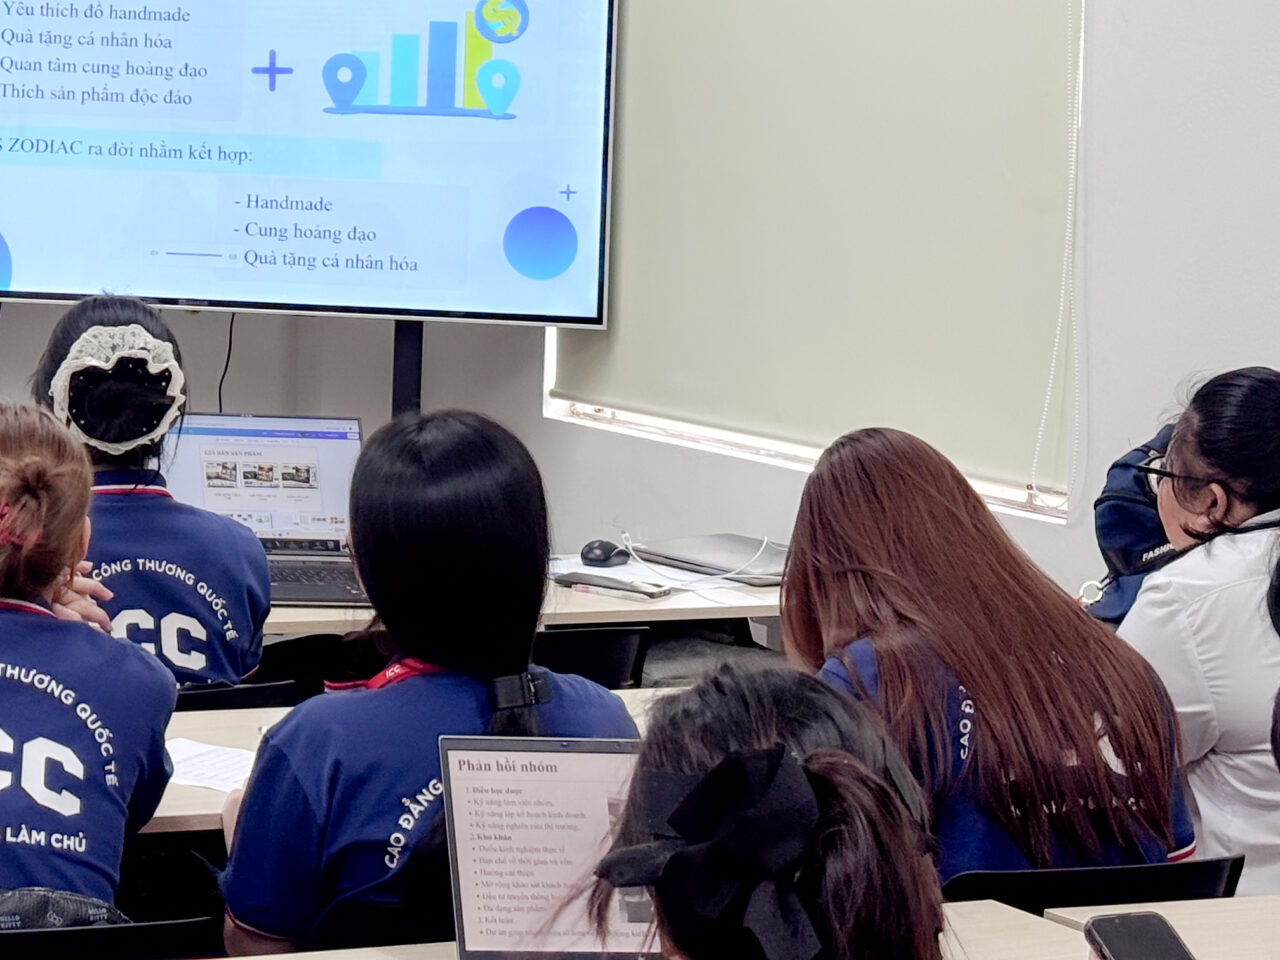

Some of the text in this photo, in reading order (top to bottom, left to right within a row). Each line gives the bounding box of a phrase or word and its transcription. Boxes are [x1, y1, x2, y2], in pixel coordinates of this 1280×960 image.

[39, 2, 78, 19] thích
[83, 0, 104, 19] đồ
[109, 4, 191, 22] handmade
[39, 30, 72, 49] tặng
[77, 31, 95, 46] cá
[100, 31, 139, 48] nhân
[144, 33, 172, 49] hóa
[0, 56, 42, 73] Quan
[48, 57, 77, 73] tâm
[82, 61, 121, 78] cung
[179, 62, 208, 79] đạo
[0, 83, 45, 100] Thích
[49, 85, 76, 101] sản
[80, 84, 125, 105] phẩm
[129, 89, 158, 106] độc
[163, 89, 192, 105] đáo
[8, 138, 83, 155] ZODIAC
[87, 145, 103, 156] ra
[108, 142, 134, 157] đời
[139, 140, 183, 159] nhằm
[188, 142, 213, 160] kết
[217, 146, 253, 165] hợp:
[246, 193, 333, 212] Handmade
[245, 222, 288, 242] Cung
[347, 225, 377, 245] đạo
[244, 250, 418, 272] Quà tặng cá nhân hóa
[92, 558, 240, 643] CÔNG THƯƠNG QUỐC TẾ
[111, 608, 207, 671] CC
[386, 664, 401, 680] ICC
[75, 702, 113, 758] QUỐC
[103, 762, 119, 787] TẾ
[959, 718, 972, 760] CAO
[458, 755, 558, 773] Phản hồi nhóm
[384, 779, 443, 868] CAO ĐẲNG
[5, 823, 46, 846] LÀM
[51, 830, 86, 853] CHỦ
